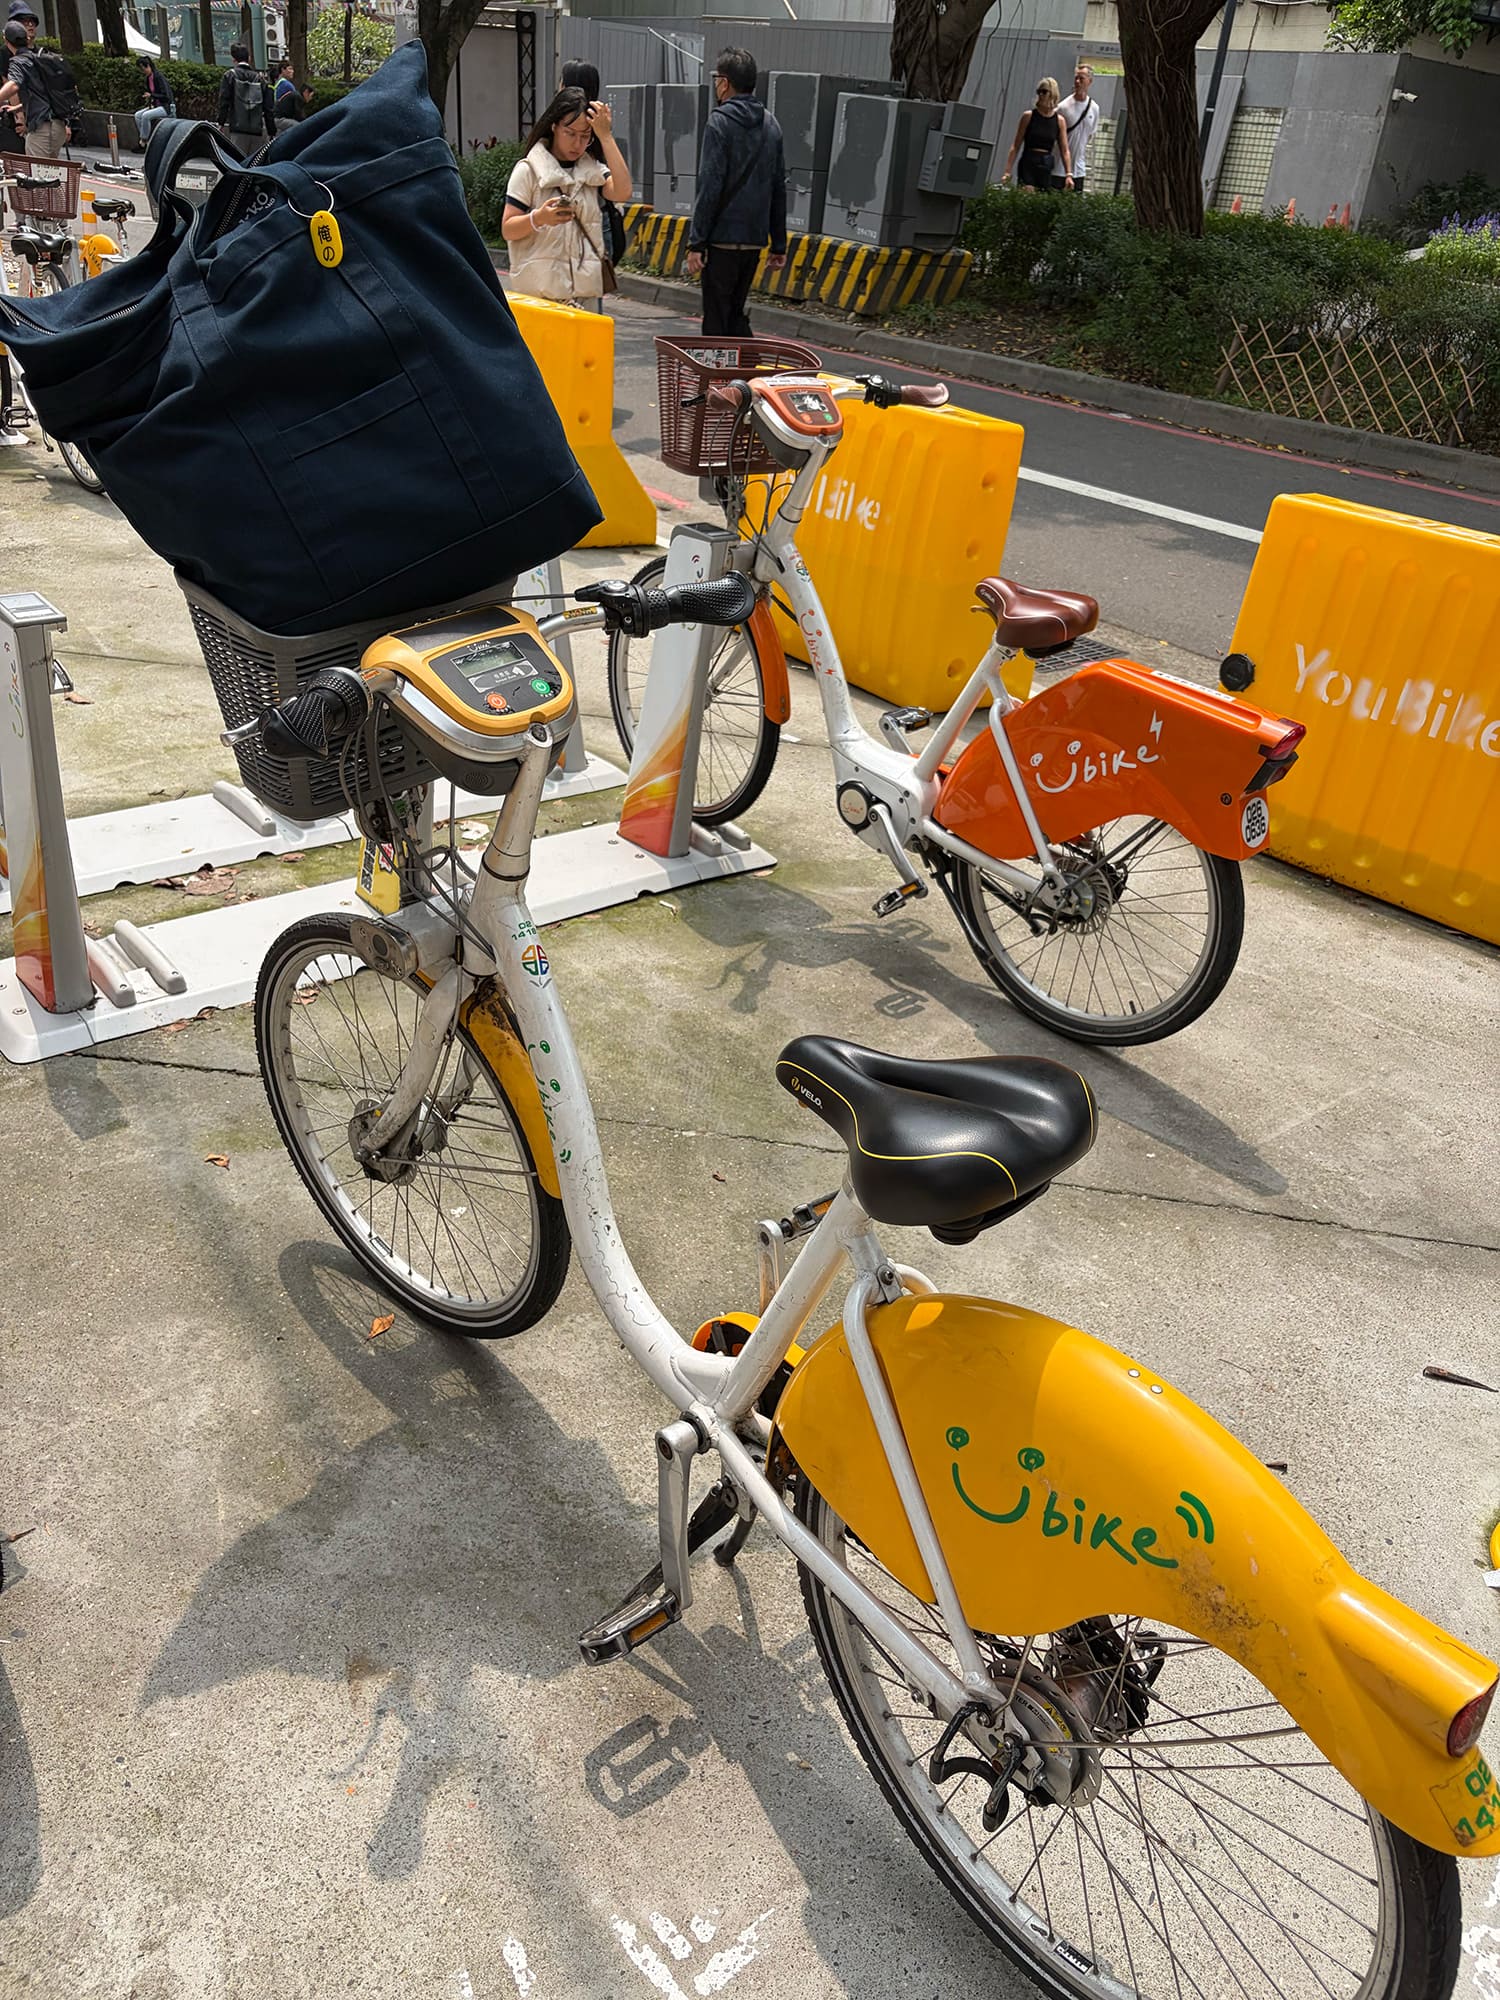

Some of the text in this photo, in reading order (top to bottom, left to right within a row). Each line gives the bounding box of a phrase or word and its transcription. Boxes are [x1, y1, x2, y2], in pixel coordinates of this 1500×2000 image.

[317, 225, 336, 262] 俺の
[1246, 800, 1263, 824] 026
[1245, 816, 1266, 843] 0636
[800, 1085, 822, 1106] VELO
